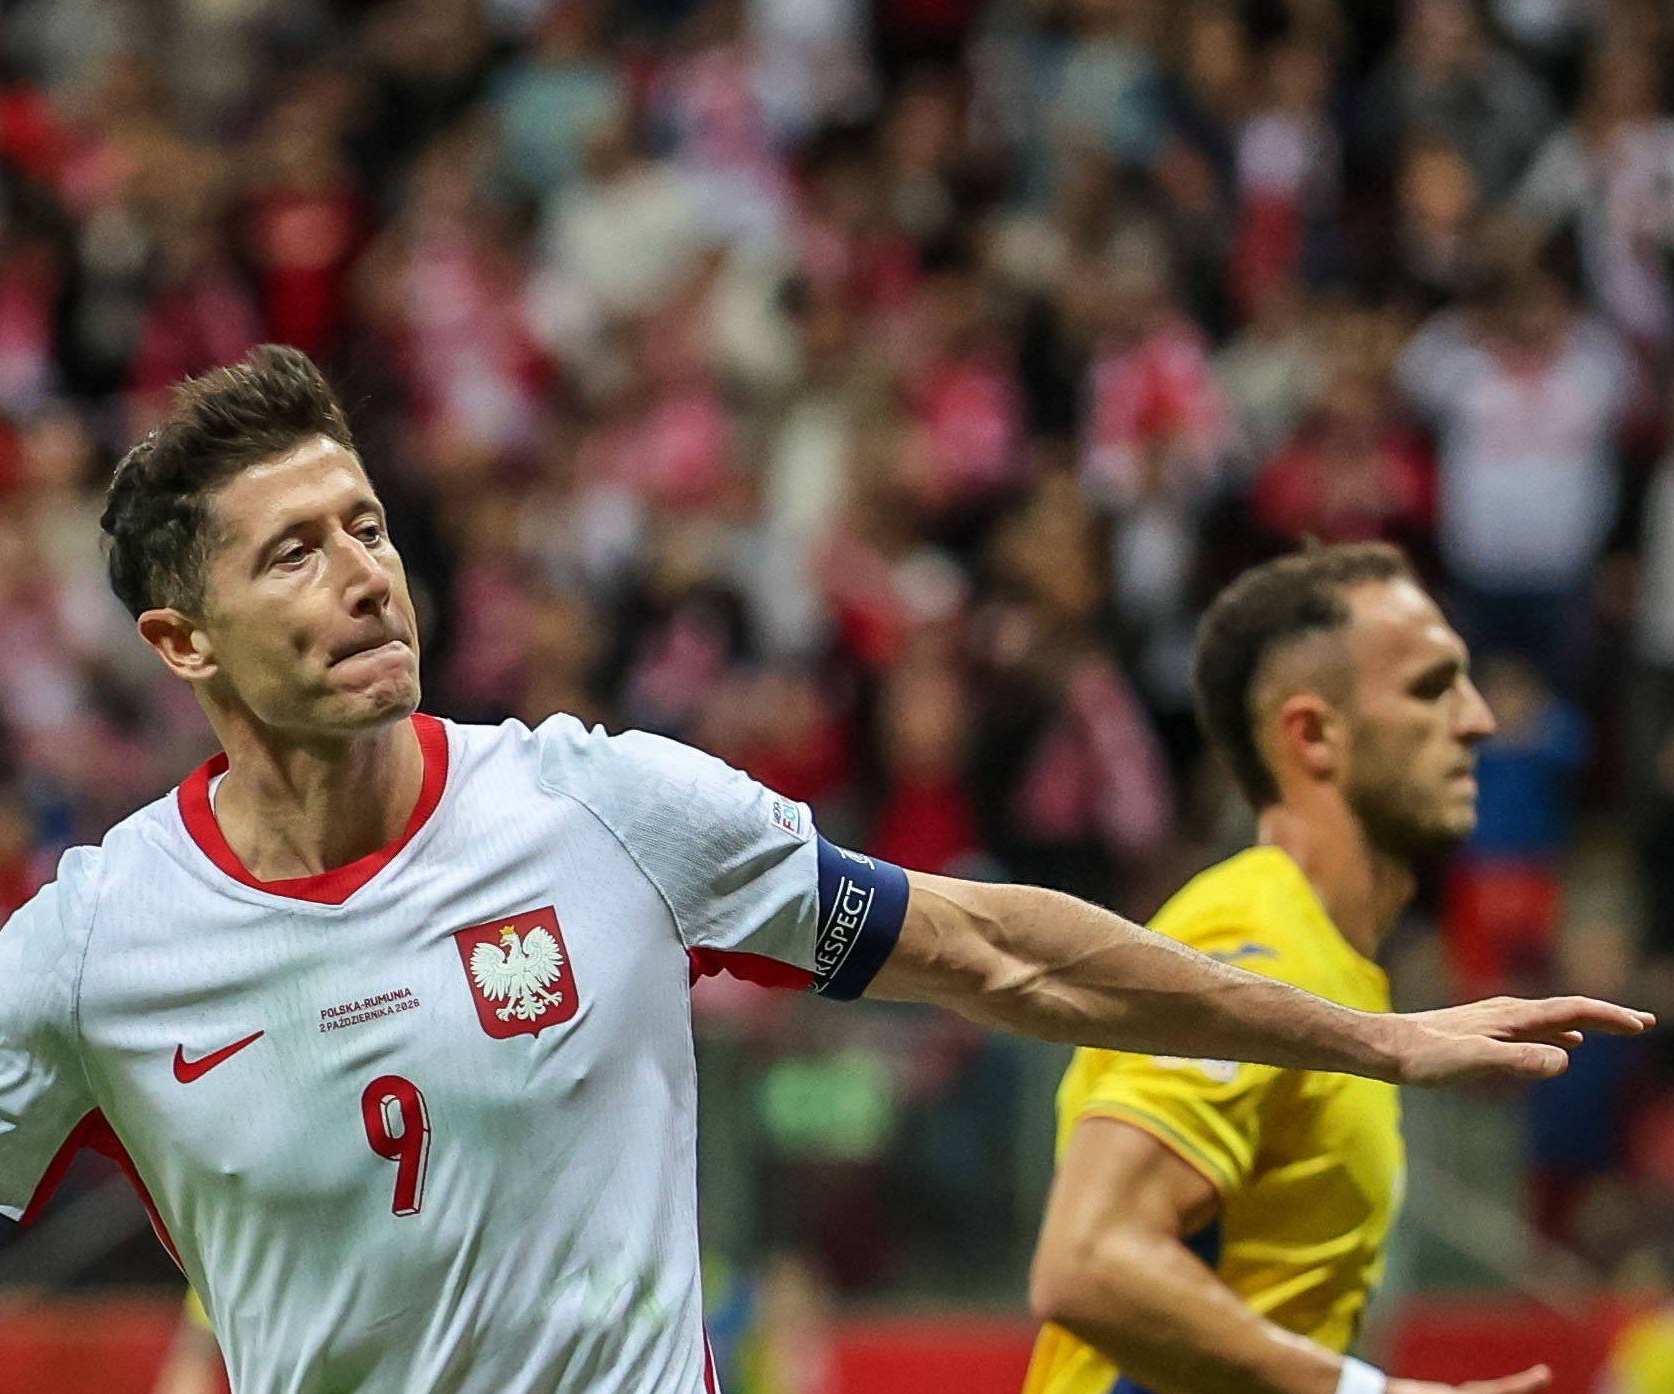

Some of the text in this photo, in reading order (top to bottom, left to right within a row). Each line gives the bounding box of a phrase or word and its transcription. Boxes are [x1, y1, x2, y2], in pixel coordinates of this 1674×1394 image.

[815, 880, 867, 977] RESPECT
[320, 987, 412, 1019] POLSKA-RUMUNIA
[326, 1006, 394, 1031] PAŹDZIERNIKA
[361, 1074, 432, 1217] 9
